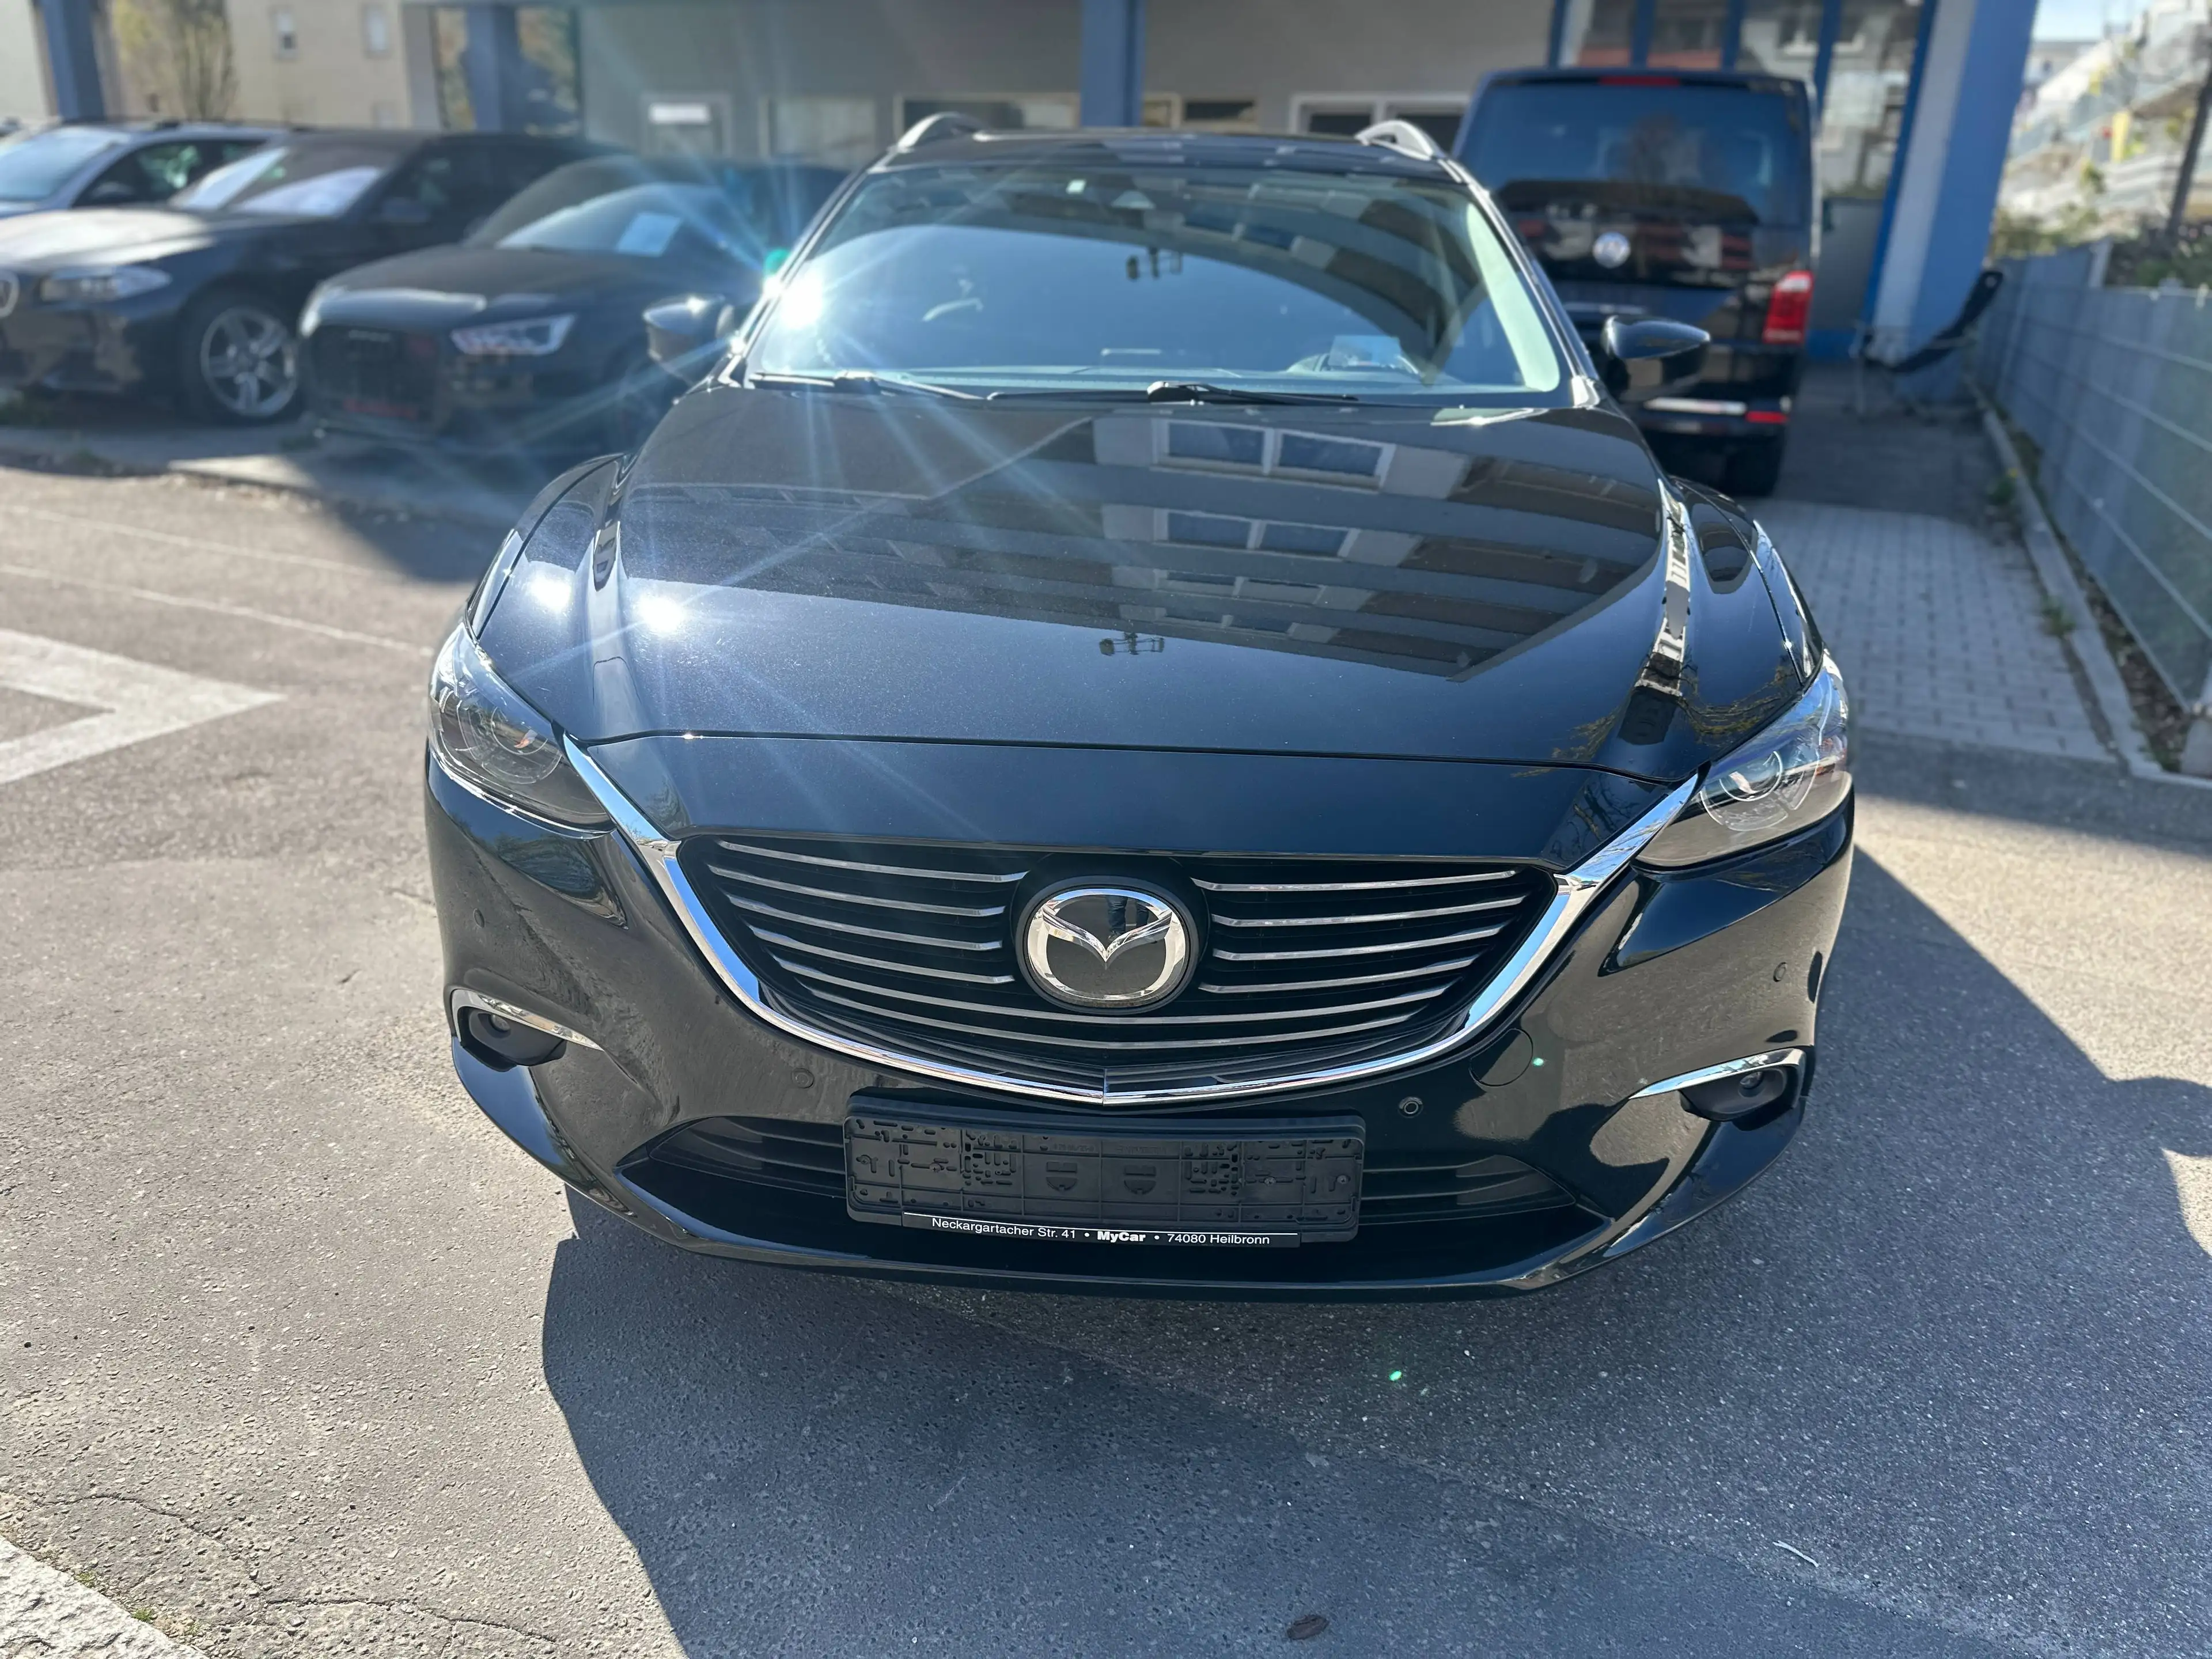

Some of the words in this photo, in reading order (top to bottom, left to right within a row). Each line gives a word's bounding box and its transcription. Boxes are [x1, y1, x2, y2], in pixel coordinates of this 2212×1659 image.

[931, 1217, 1034, 1236] Neckargartacher
[1037, 1228, 1058, 1238] Str.
[1061, 1229, 1076, 1239] 41
[1097, 1230, 1146, 1243] MyCar
[1167, 1233, 1206, 1243] 74080
[1210, 1234, 1270, 1244] Heilbronn
